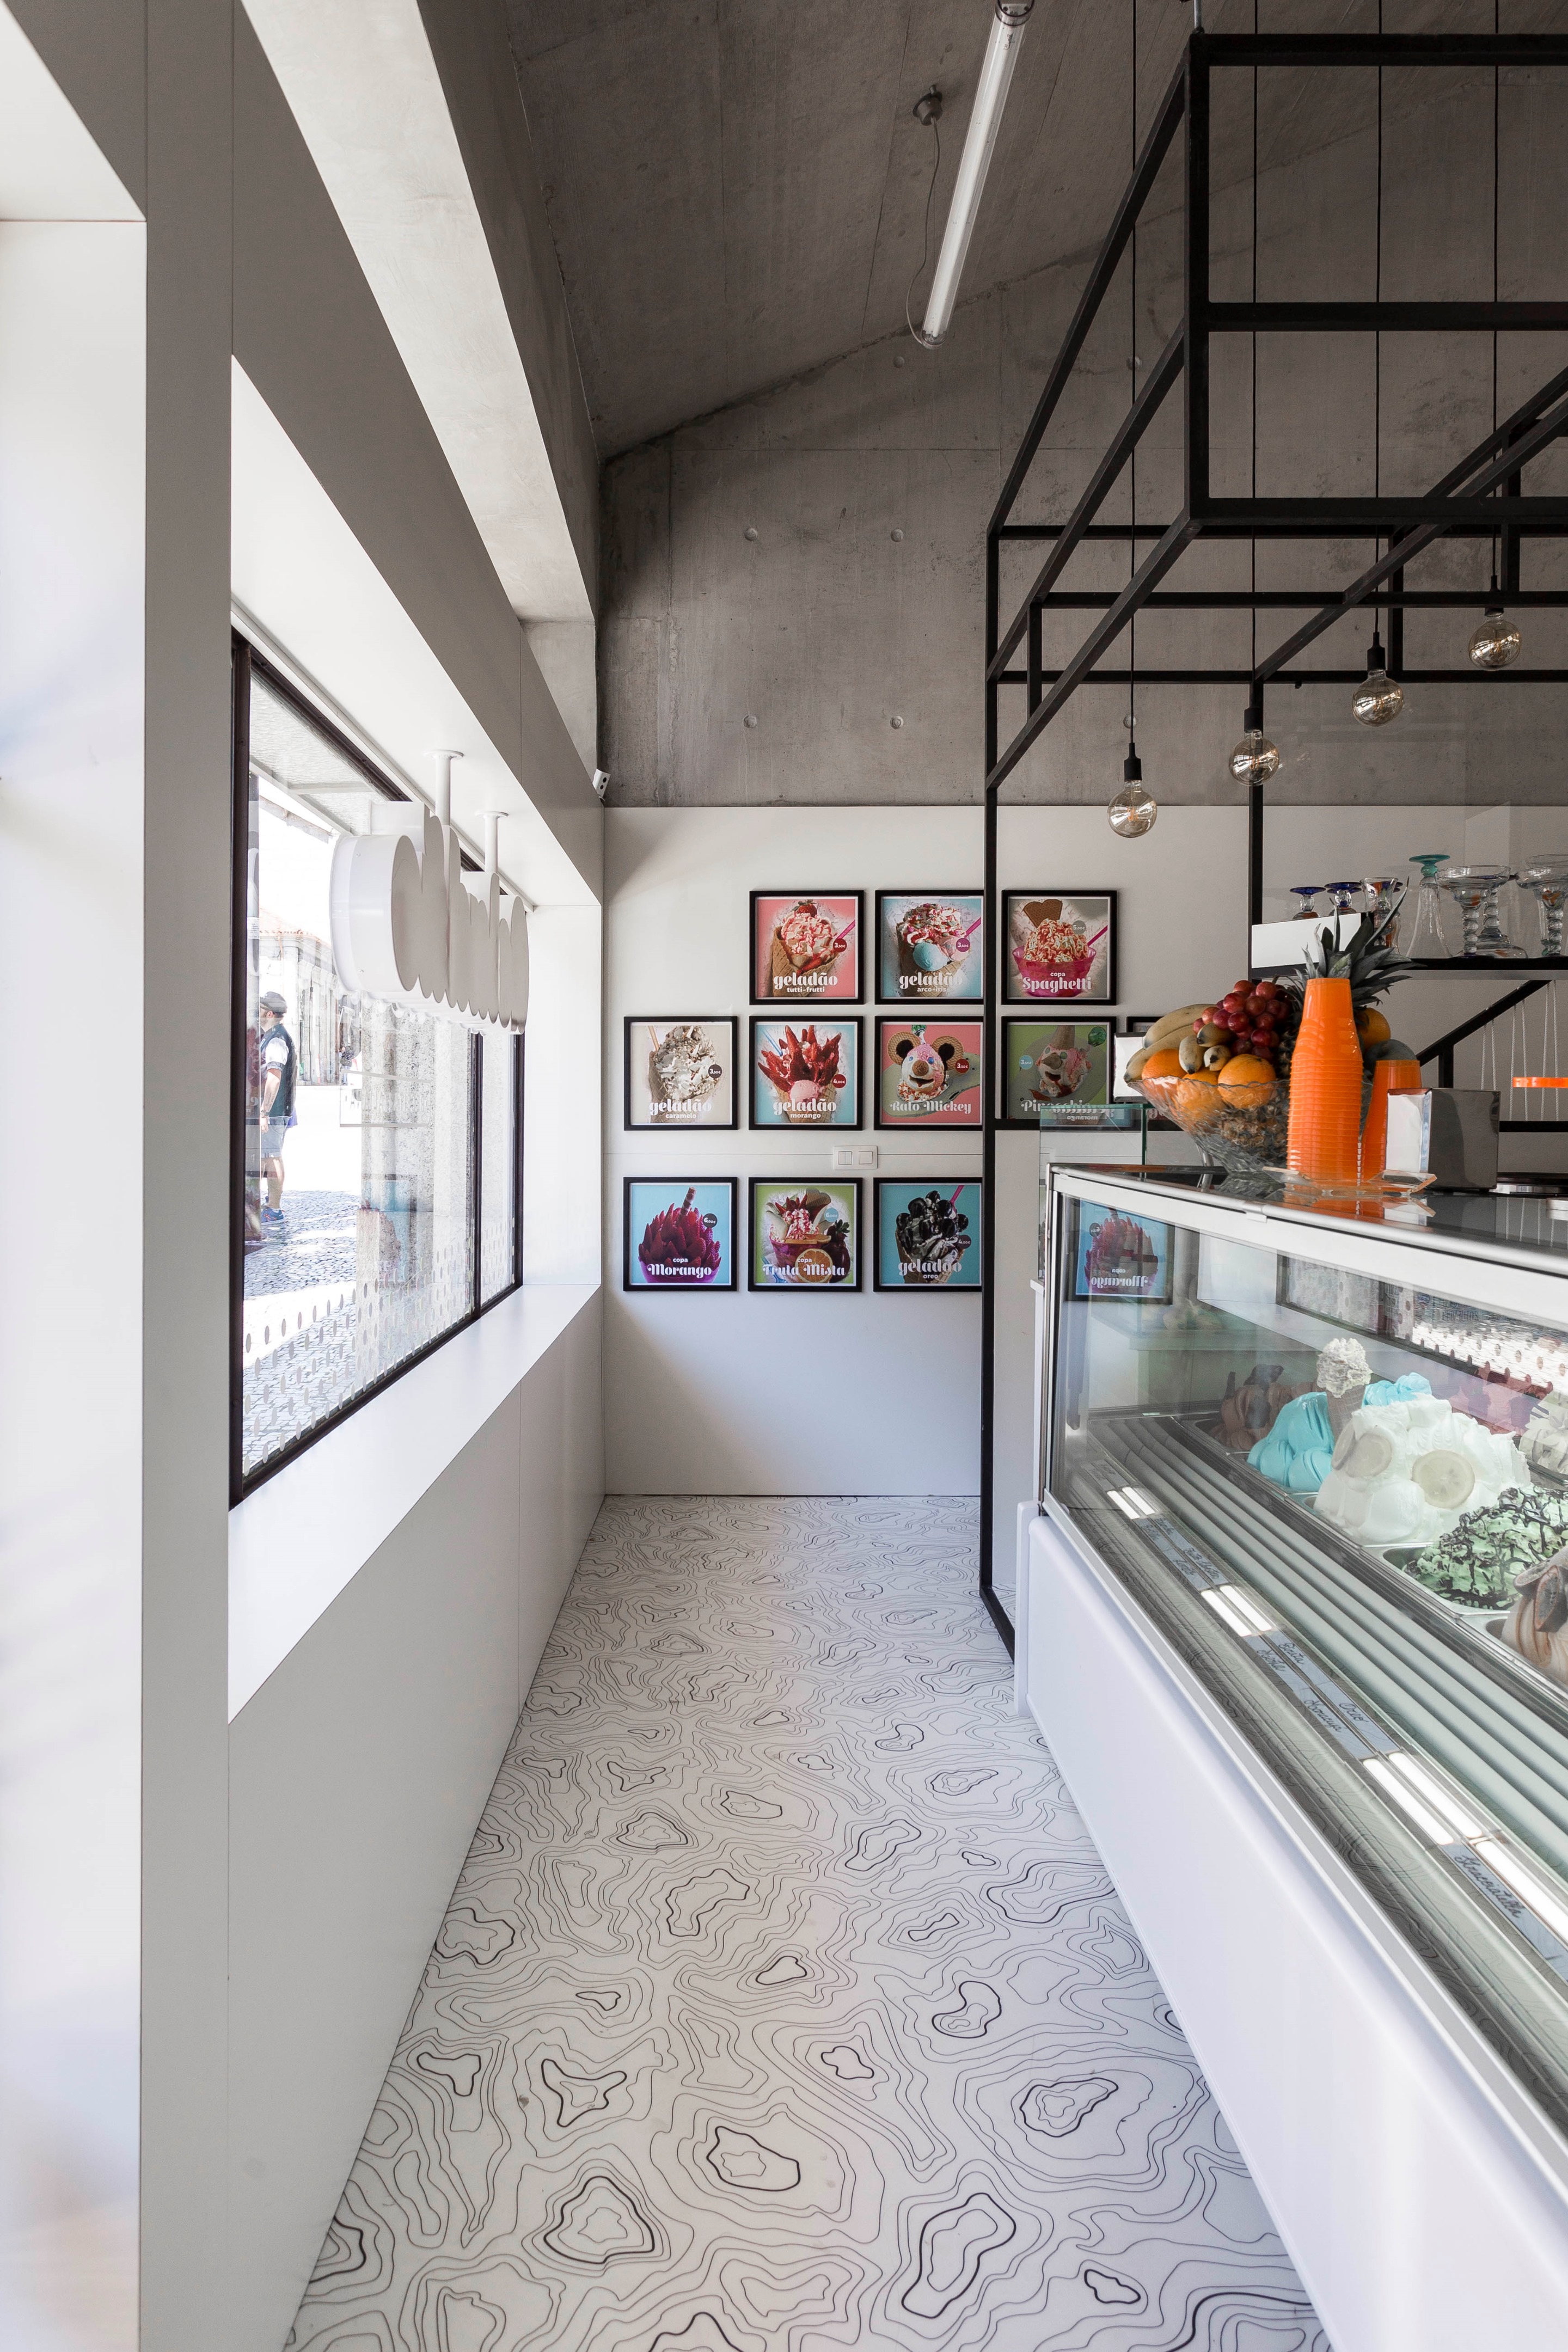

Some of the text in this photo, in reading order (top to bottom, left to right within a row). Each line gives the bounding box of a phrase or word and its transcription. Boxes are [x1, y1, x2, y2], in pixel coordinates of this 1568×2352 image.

[773, 972, 838, 990] geladão
[899, 972, 963, 989] geladão
[1022, 977, 1092, 993] Spaghetti
[649, 1098, 712, 1116] geladão
[773, 1098, 837, 1115] geladão
[890, 1100, 971, 1114] Rato Mickey
[647, 1264, 712, 1278] Morango
[763, 1264, 845, 1276] Fruta Mista
[1339, 1702, 1369, 1722] Oreo
